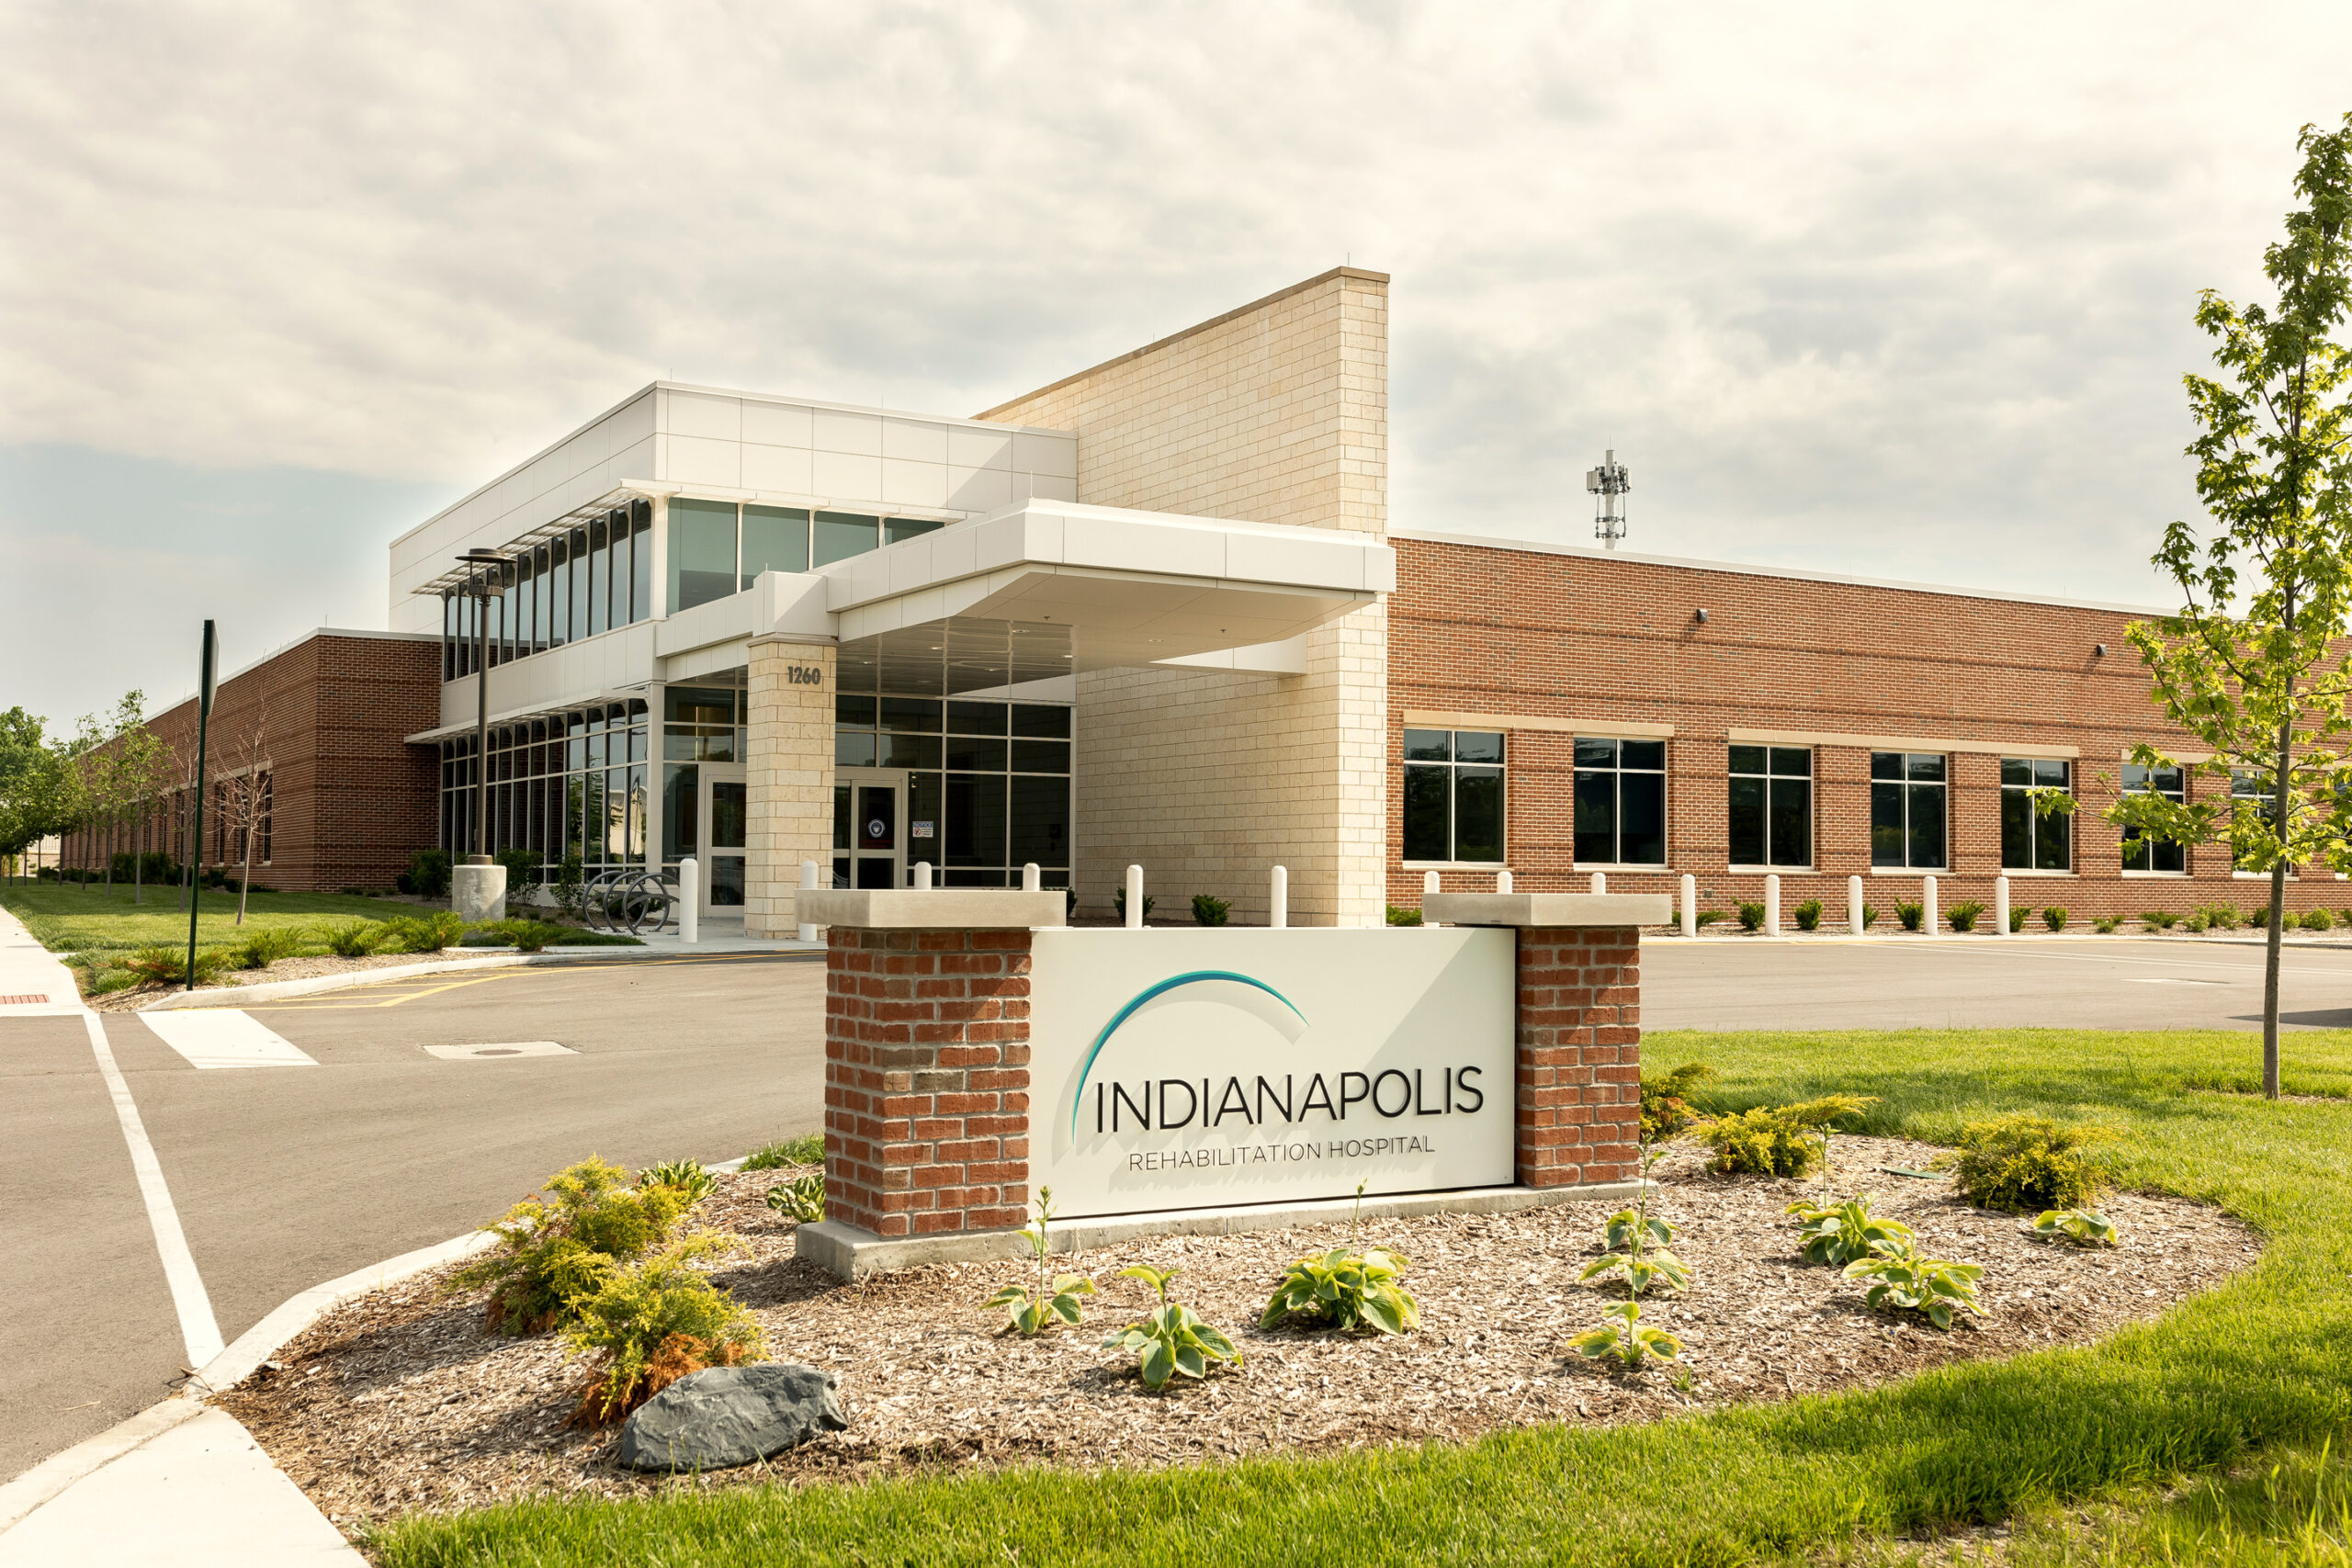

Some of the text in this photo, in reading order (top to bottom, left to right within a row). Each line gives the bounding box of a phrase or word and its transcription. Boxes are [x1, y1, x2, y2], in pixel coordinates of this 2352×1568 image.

[787, 666, 820, 684] 1260
[1097, 1066, 1484, 1134] INDIANAPOLIS
[1129, 1135, 1435, 1171] REHABILITATION HOSPITAL
